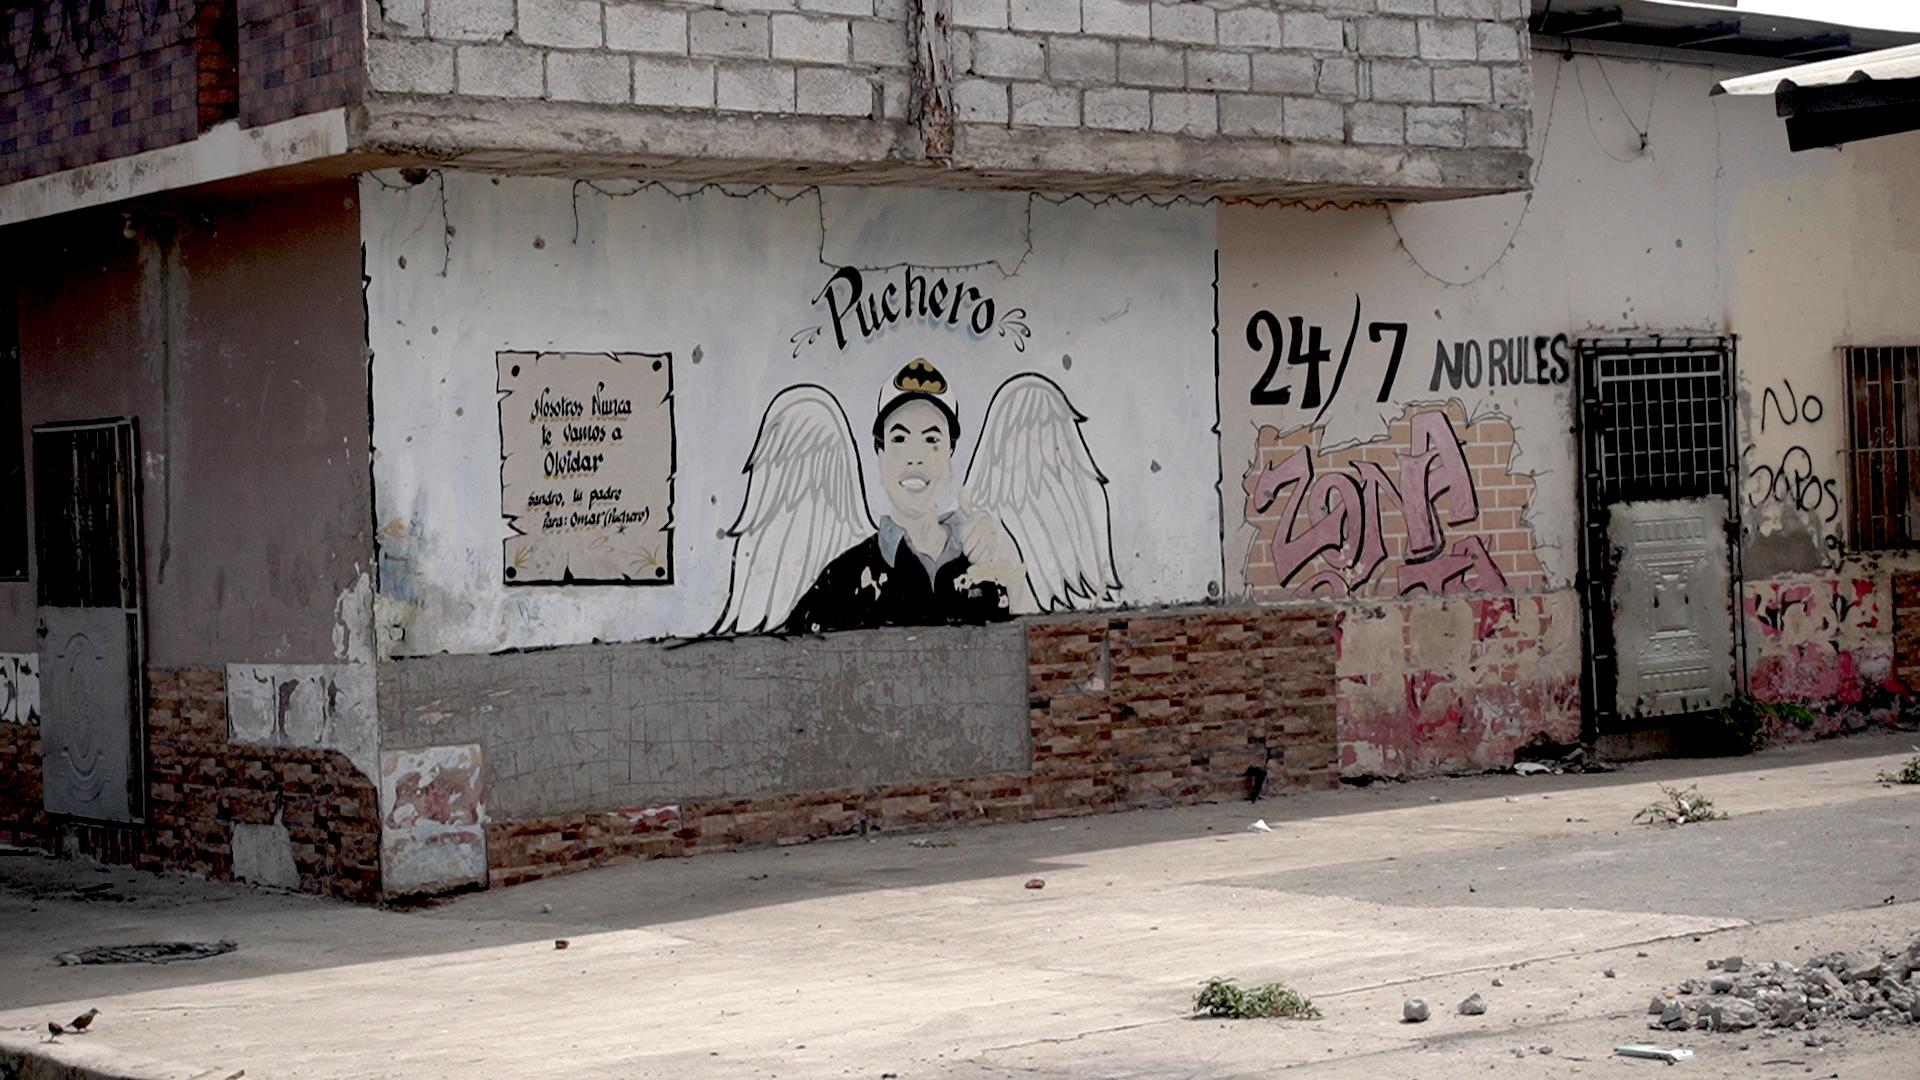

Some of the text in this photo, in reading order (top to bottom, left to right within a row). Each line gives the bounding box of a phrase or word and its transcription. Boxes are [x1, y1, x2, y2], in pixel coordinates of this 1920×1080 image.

[811, 265, 996, 351] Puchero
[1246, 292, 1571, 429] 24/7 NO RULES
[531, 381, 632, 420] Nosotros Nunca
[1761, 378, 1823, 433] No
[541, 424, 552, 446] te
[611, 427, 623, 441] a
[544, 450, 604, 477] Olvidar
[588, 485, 622, 510] padre
[570, 511, 605, 528] Omar
